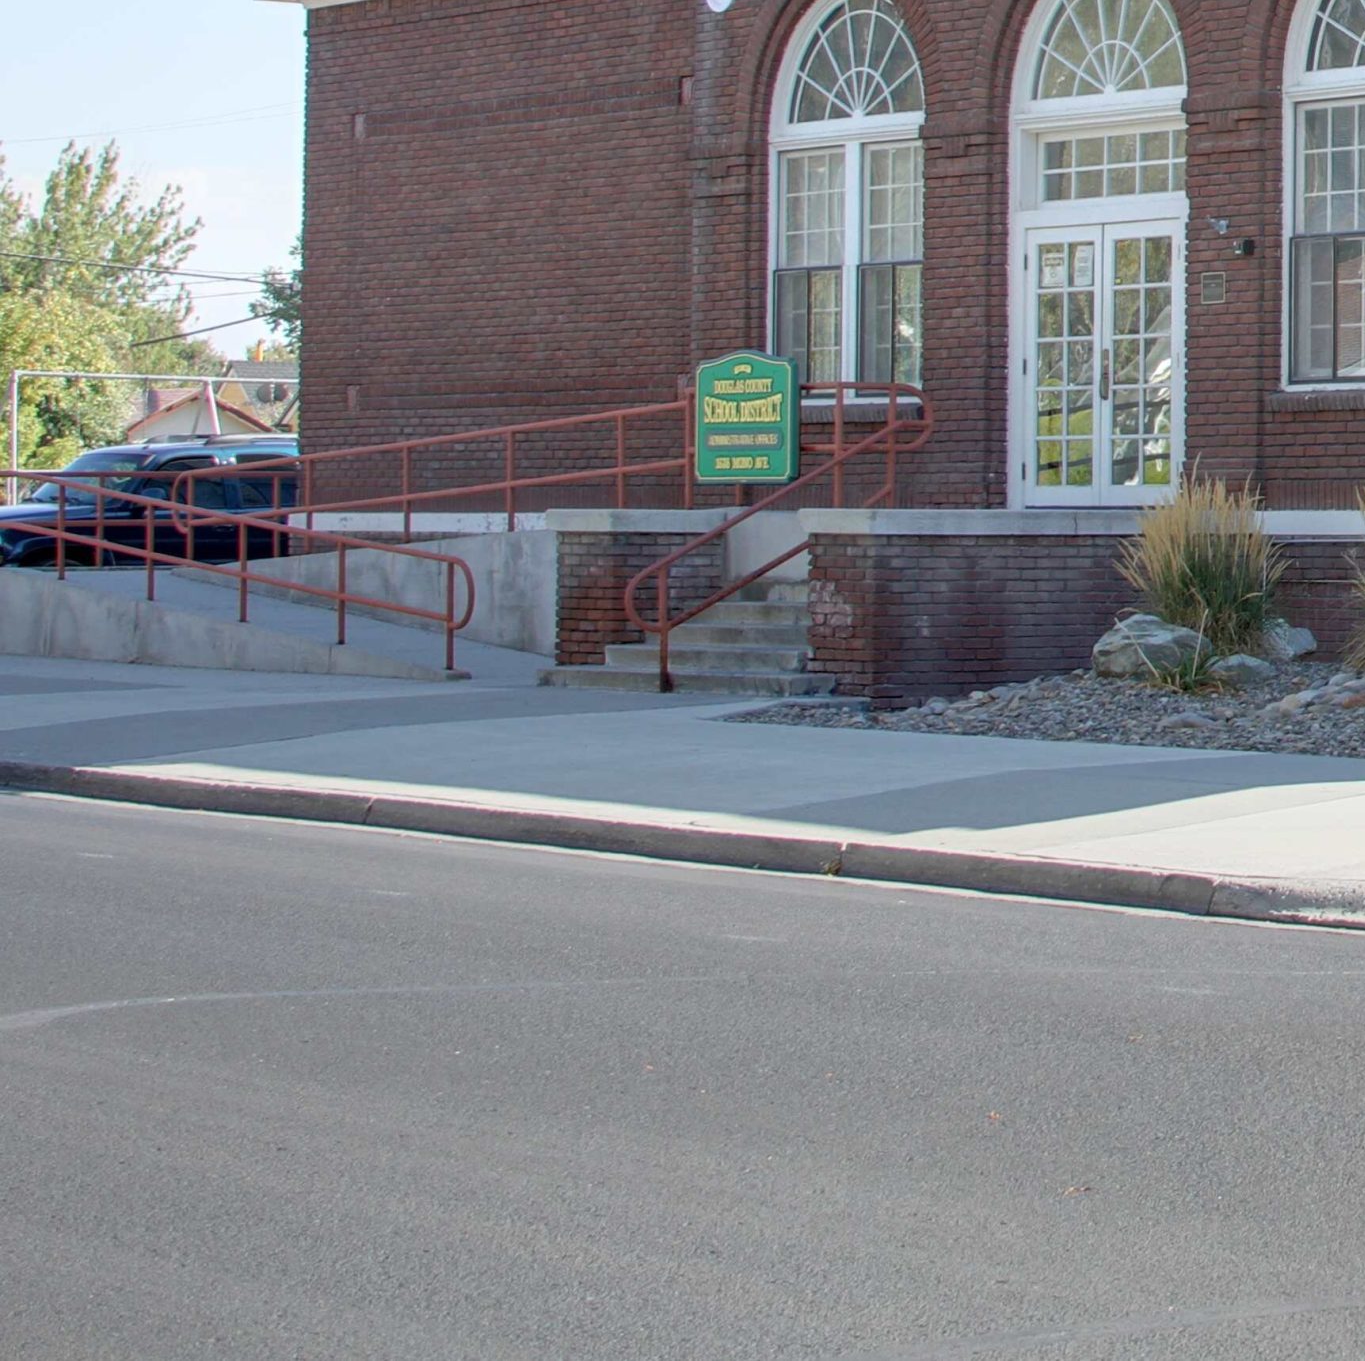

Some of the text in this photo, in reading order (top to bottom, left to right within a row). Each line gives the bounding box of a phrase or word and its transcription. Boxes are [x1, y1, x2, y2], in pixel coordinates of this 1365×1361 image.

[714, 379, 773, 394] DOUGLAS COUNTY
[704, 393, 782, 423] SCHOOL DISTRICT
